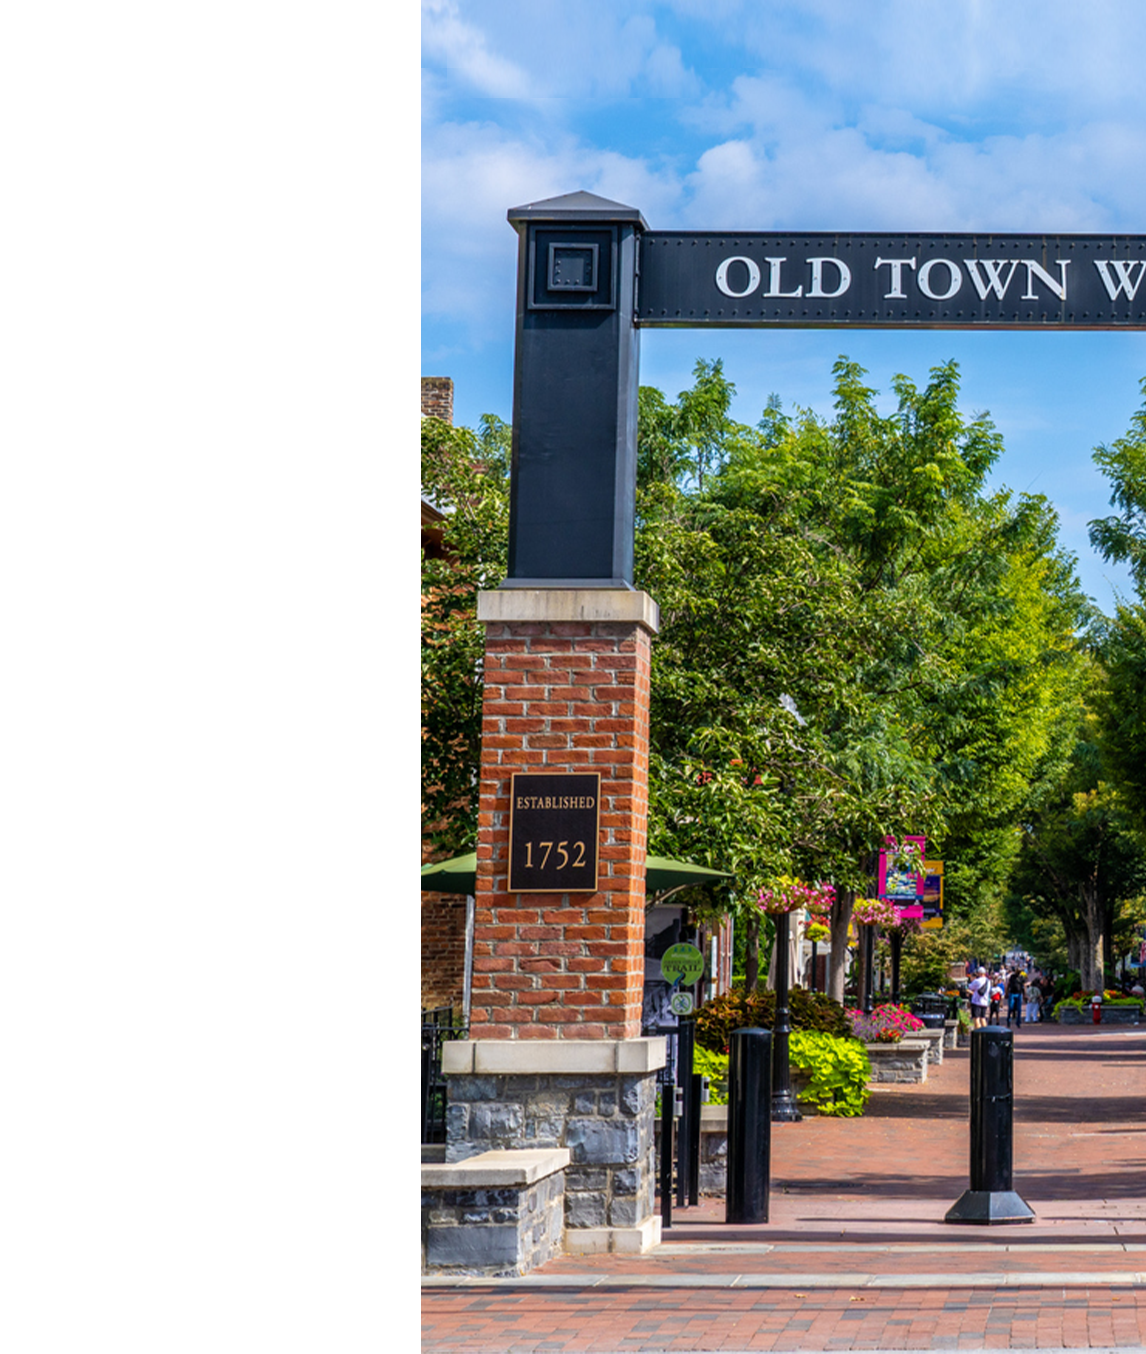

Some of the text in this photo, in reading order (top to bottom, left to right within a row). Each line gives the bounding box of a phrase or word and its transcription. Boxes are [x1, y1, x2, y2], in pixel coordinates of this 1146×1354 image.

[716, 256, 851, 299] OLD
[874, 257, 1071, 301] TOWN
[516, 796, 595, 809] ESTABLISHED
[524, 841, 586, 870] 1752
